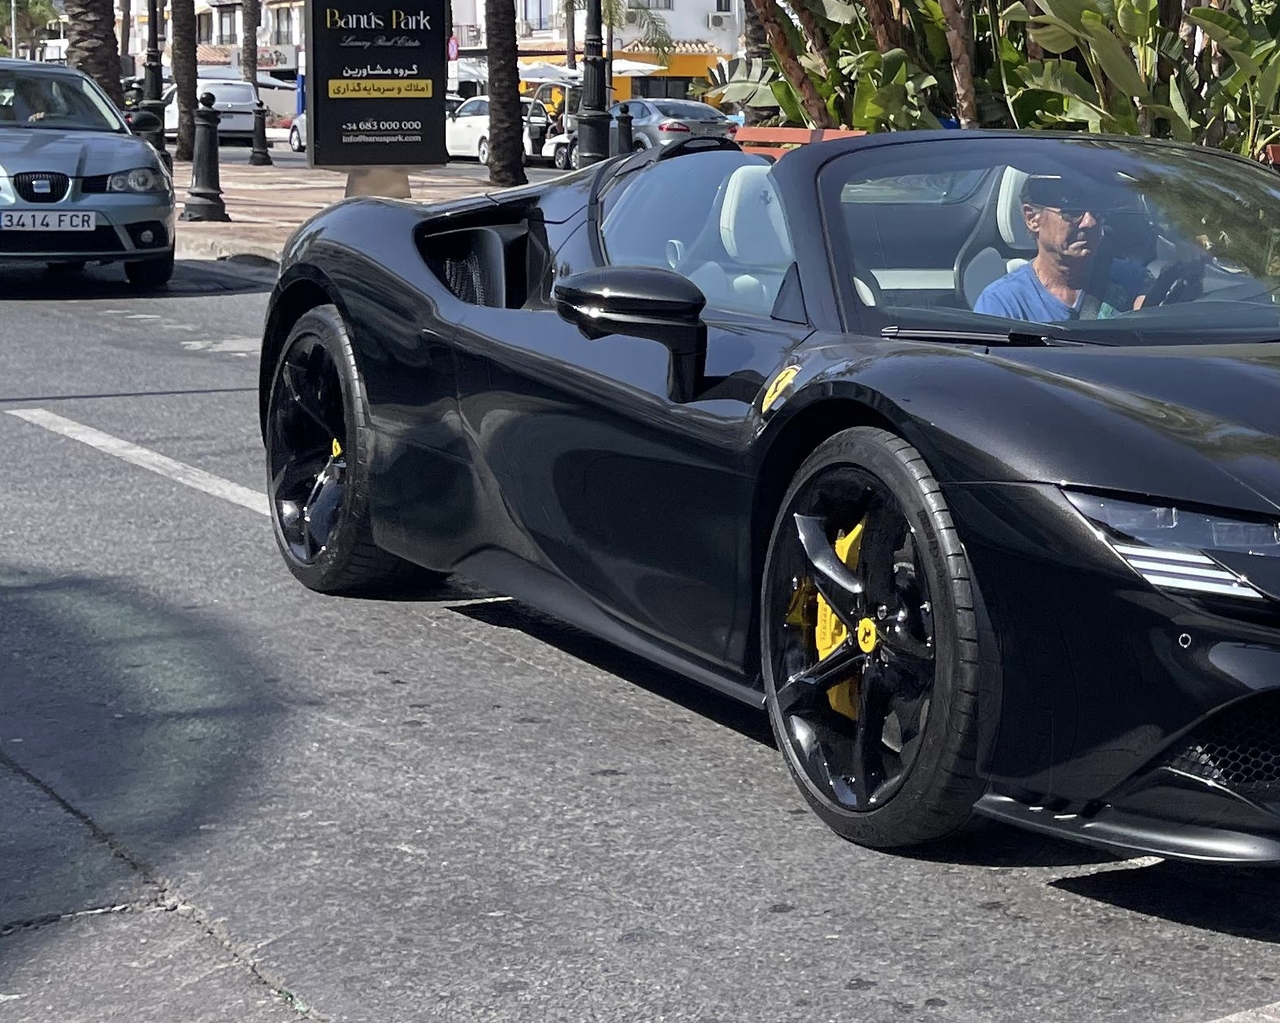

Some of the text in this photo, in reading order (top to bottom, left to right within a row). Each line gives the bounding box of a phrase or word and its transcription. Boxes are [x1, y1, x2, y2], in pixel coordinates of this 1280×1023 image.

[326, 8, 431, 30] Banús Park
[359, 121, 378, 130] 683
[380, 121, 399, 130] 000
[401, 121, 421, 130] 000
[4, 214, 91, 228] 3414 FCR
